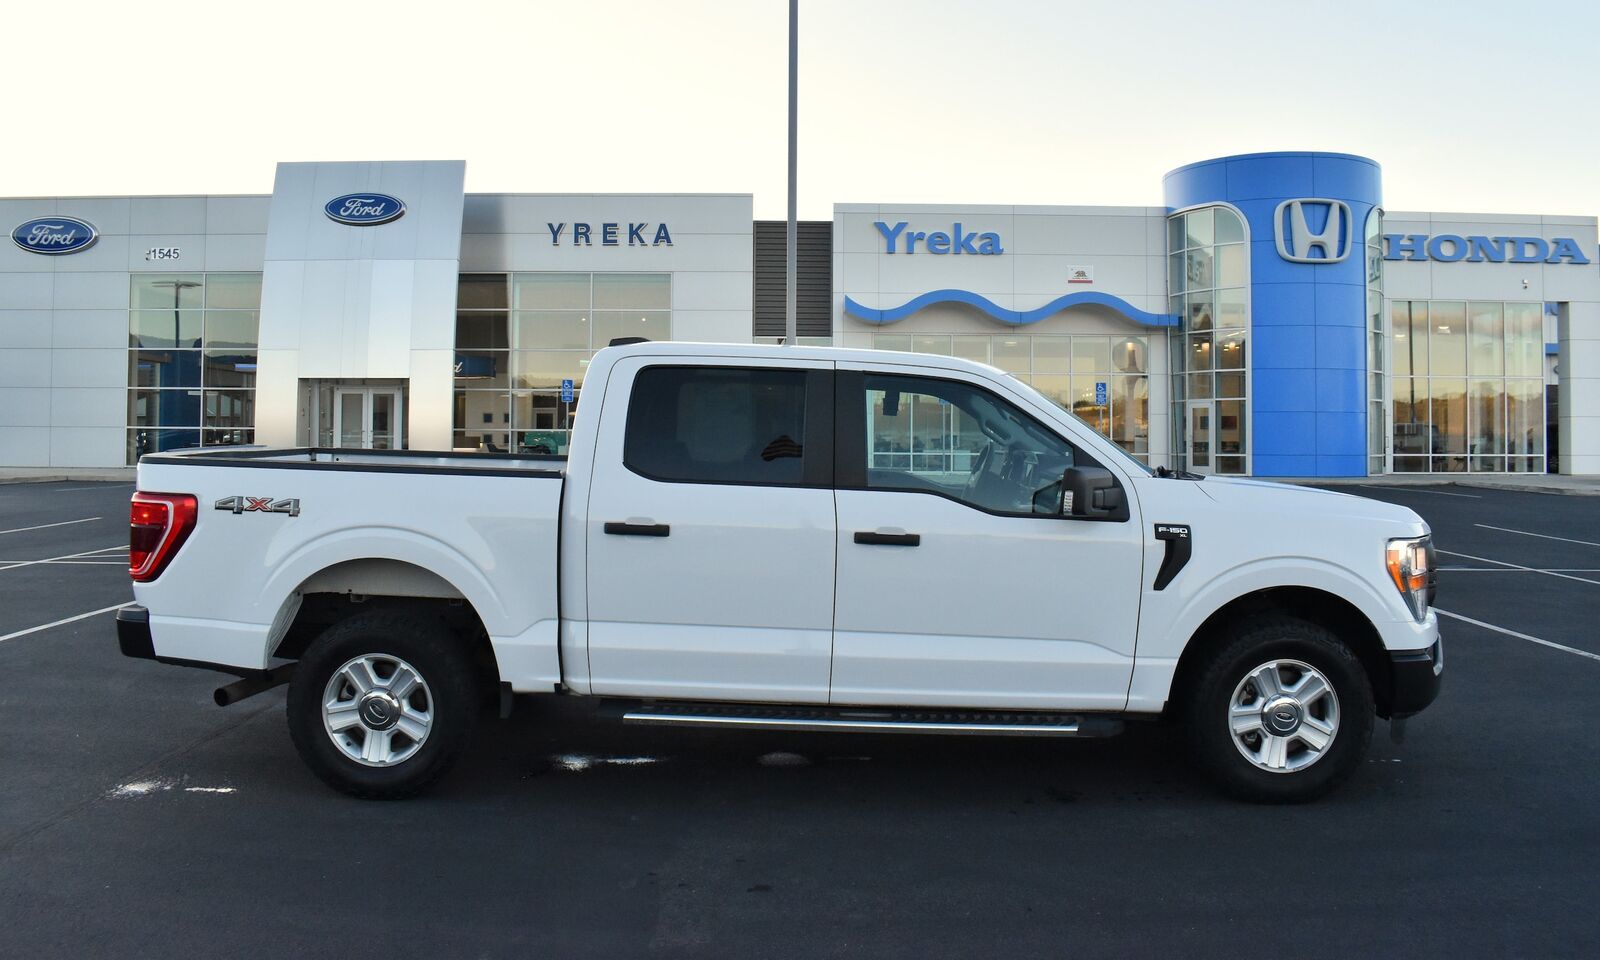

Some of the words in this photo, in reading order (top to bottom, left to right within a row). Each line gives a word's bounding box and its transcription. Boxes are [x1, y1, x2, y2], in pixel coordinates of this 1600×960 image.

[340, 198, 386, 216] Ford
[26, 224, 75, 245] Ford
[547, 222, 673, 246] YREKA
[873, 221, 1004, 255] Yreka
[151, 248, 180, 259] 1545
[1383, 233, 1590, 265] HONDA
[1158, 526, 1188, 534] F-150
